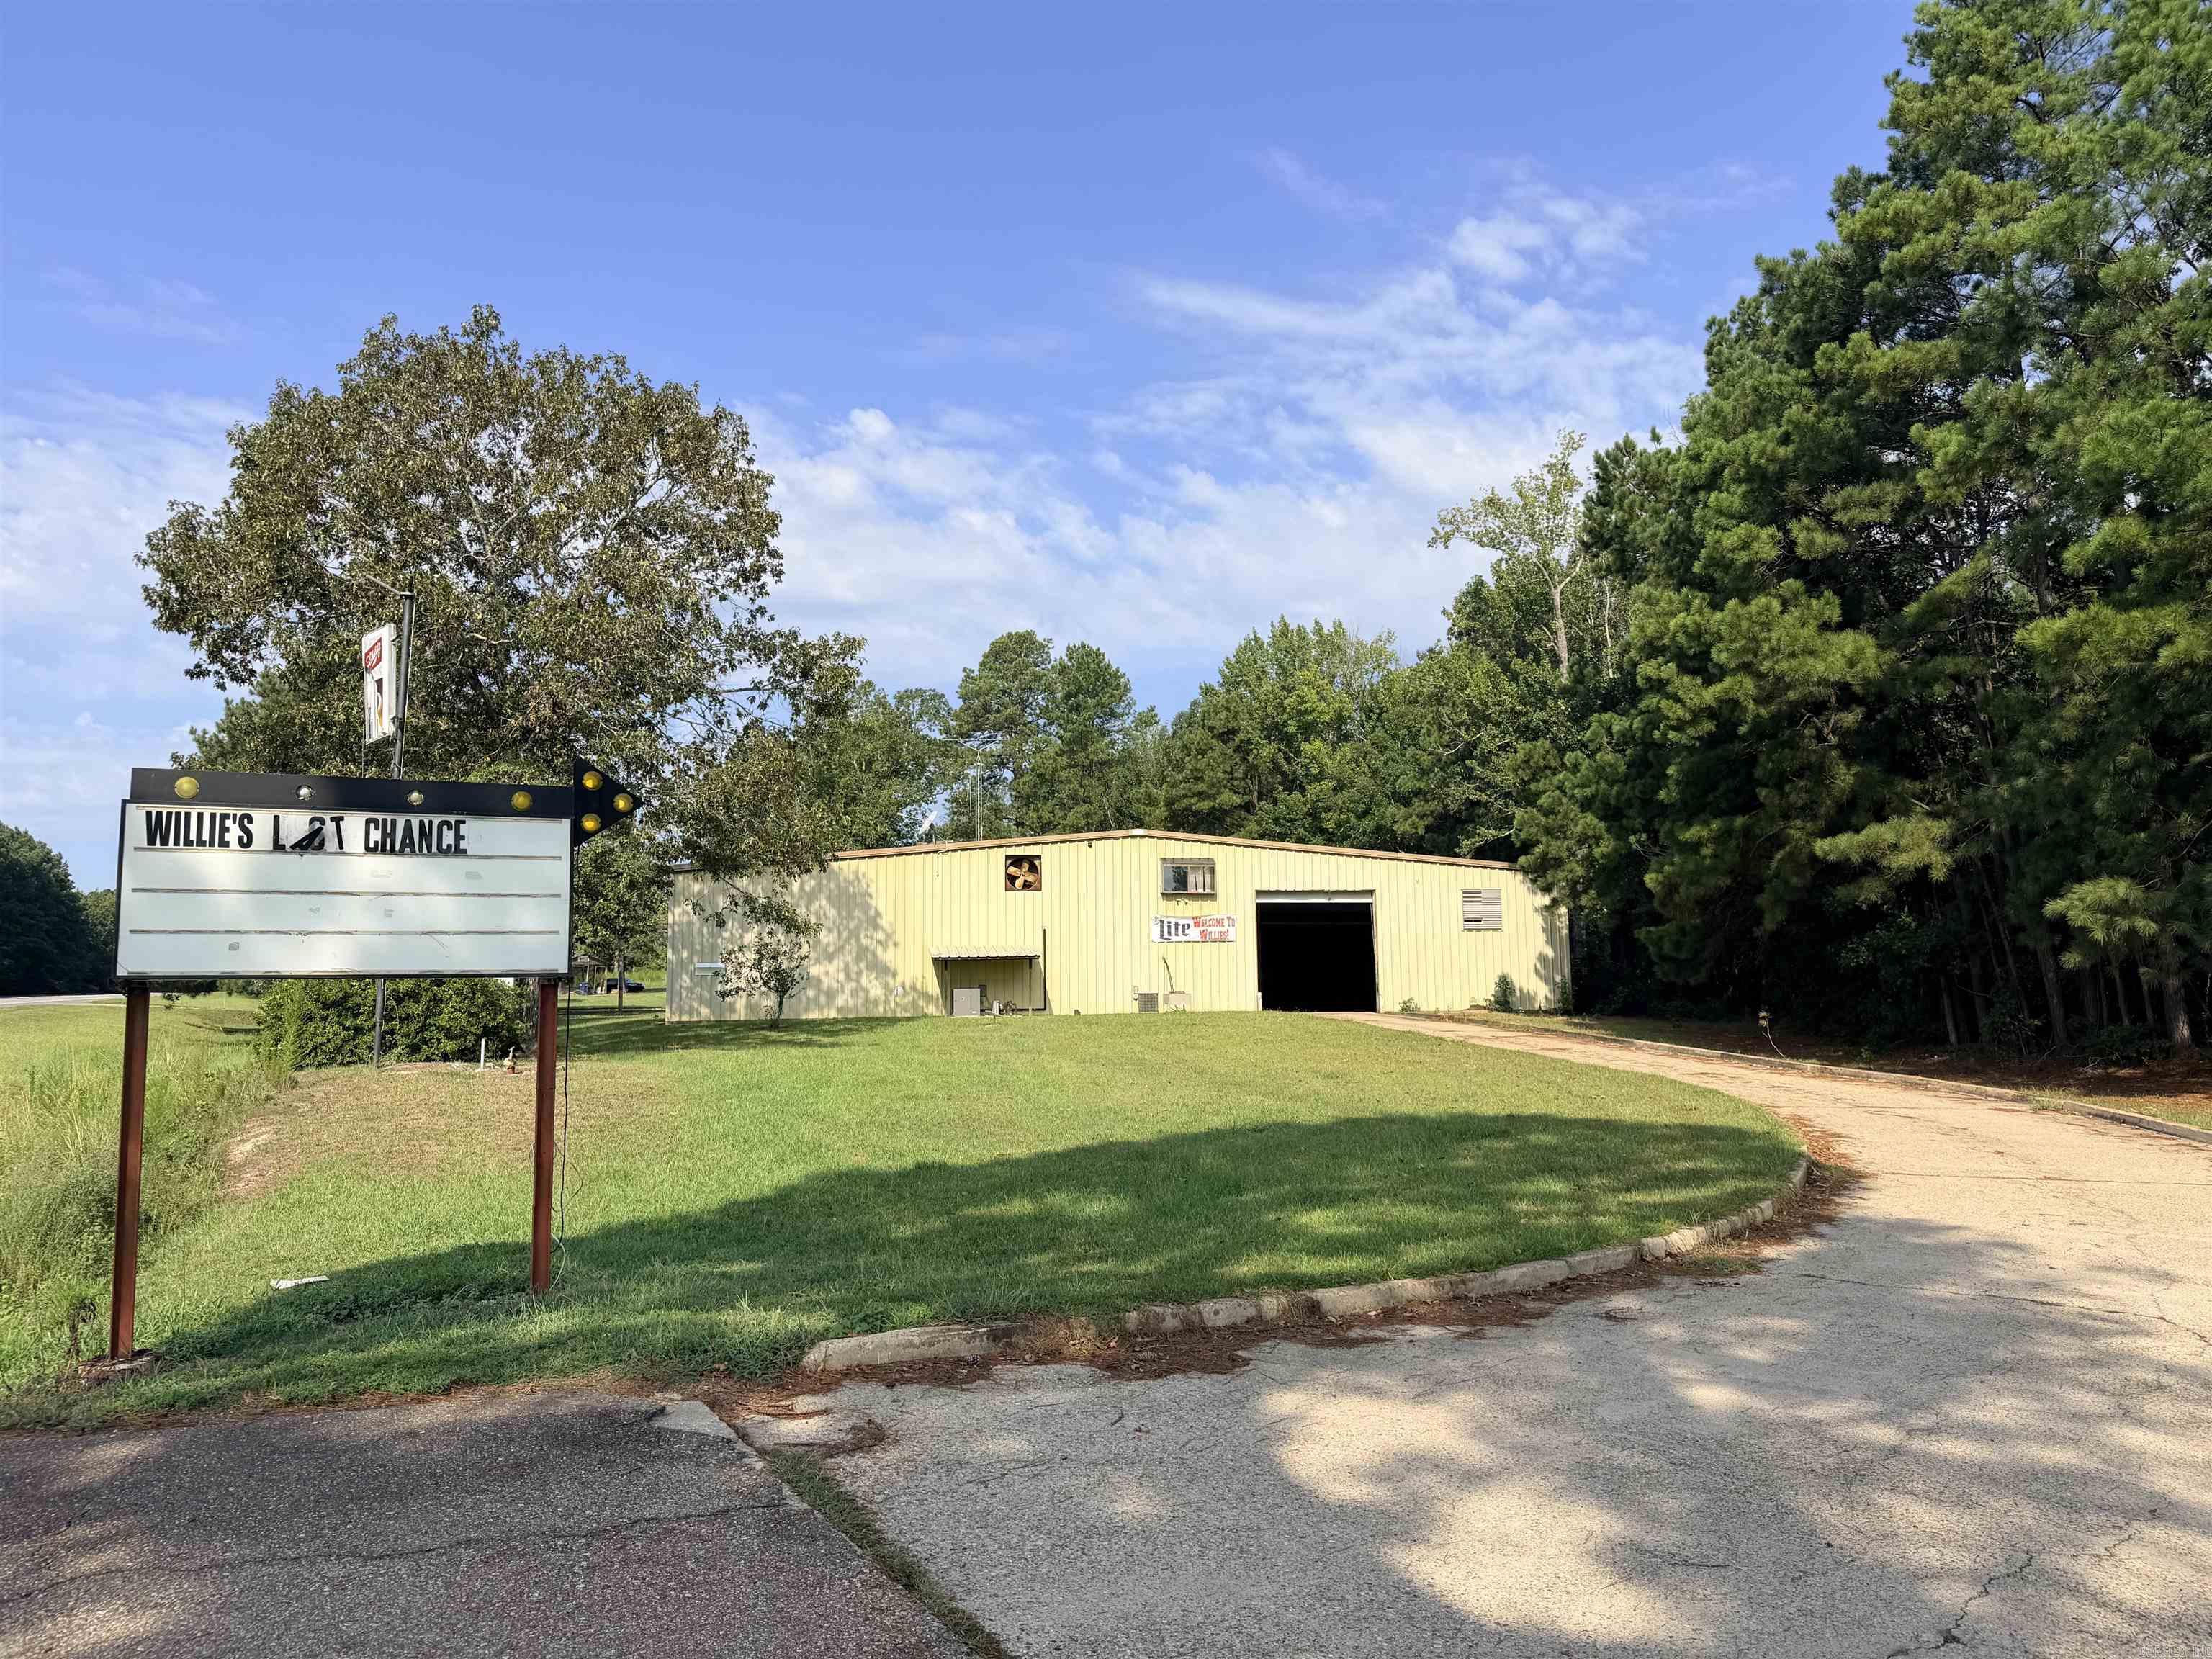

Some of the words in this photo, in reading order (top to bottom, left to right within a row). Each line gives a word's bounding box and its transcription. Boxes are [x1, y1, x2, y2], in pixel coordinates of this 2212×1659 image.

[145, 811, 253, 849] WILLIE'S
[364, 818, 467, 854] CHANCE
[1159, 920, 1190, 940] Lite
